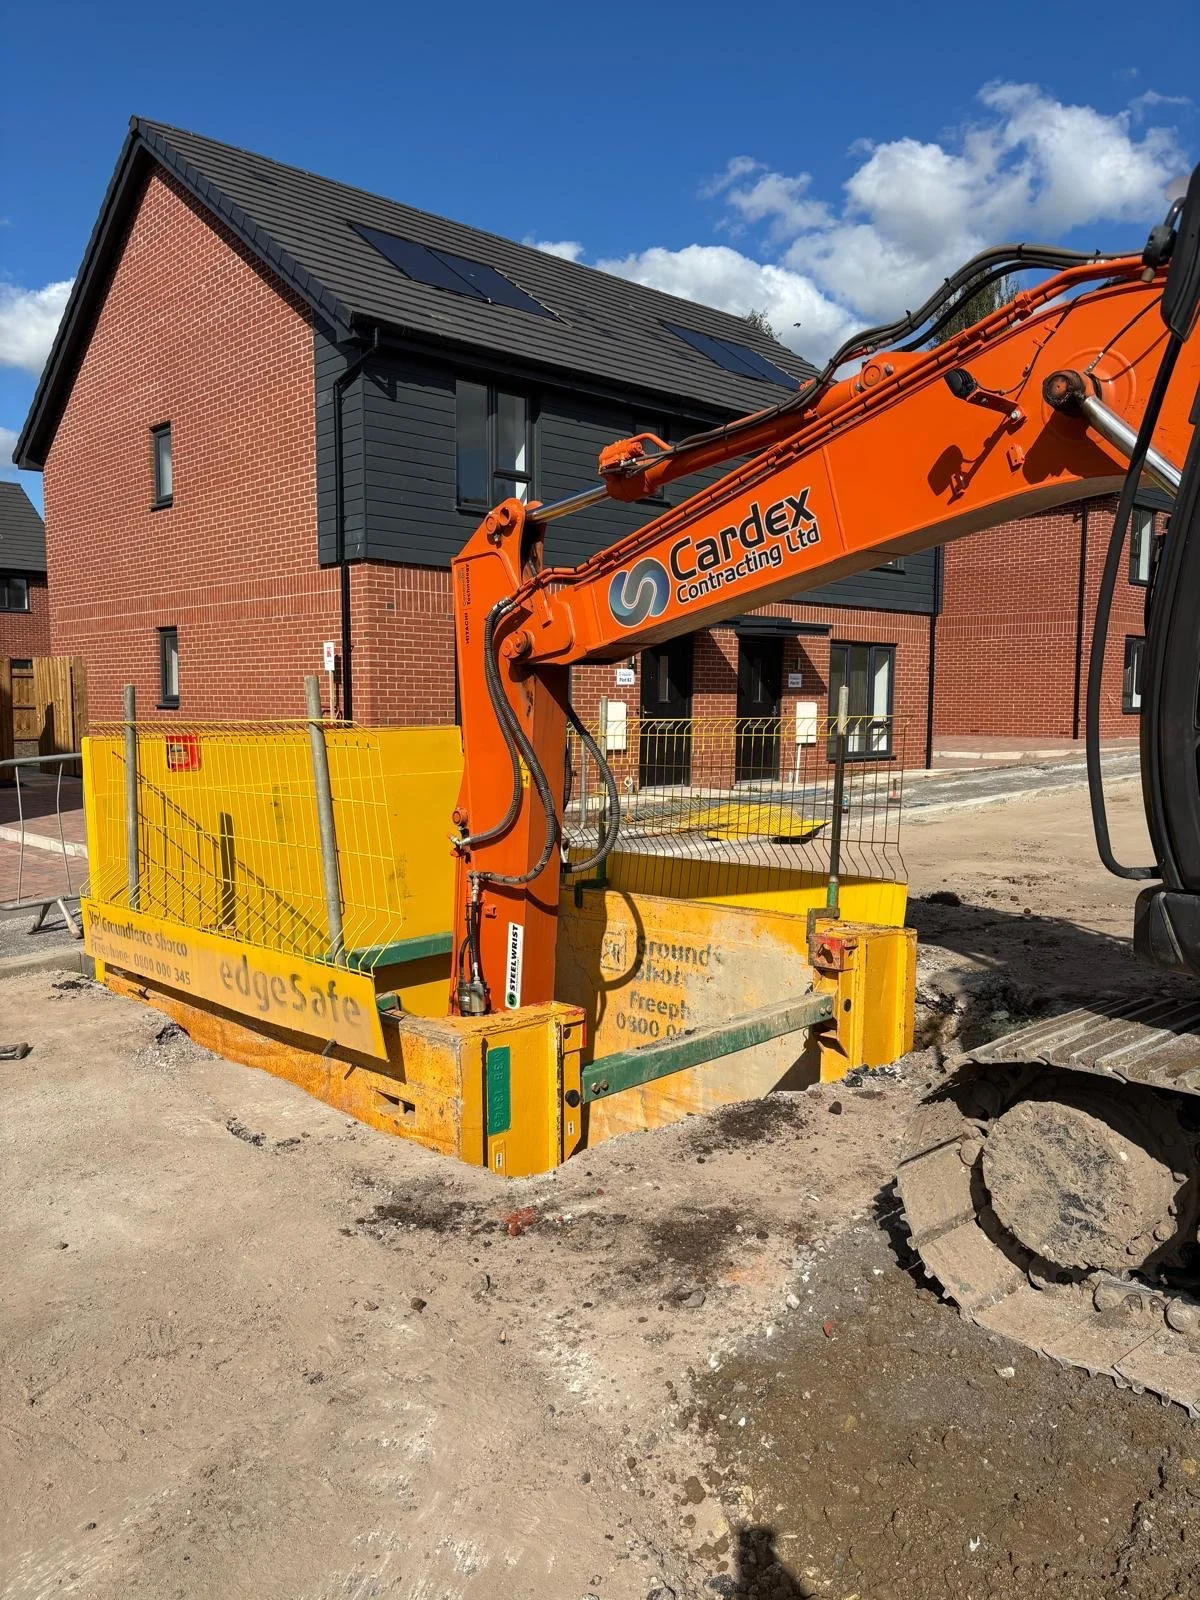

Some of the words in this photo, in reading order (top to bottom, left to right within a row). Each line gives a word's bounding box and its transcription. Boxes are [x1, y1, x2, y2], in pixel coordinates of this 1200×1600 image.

[677, 544, 782, 604] Contracting
[785, 522, 820, 553] Ltd
[102, 917, 154, 948] Groundforce
[509, 924, 519, 992] STEELWRIST
[134, 952, 154, 973] 0800
[156, 961, 172, 979] 000
[174, 967, 191, 986] 345
[220, 954, 361, 1026] edgeSafe
